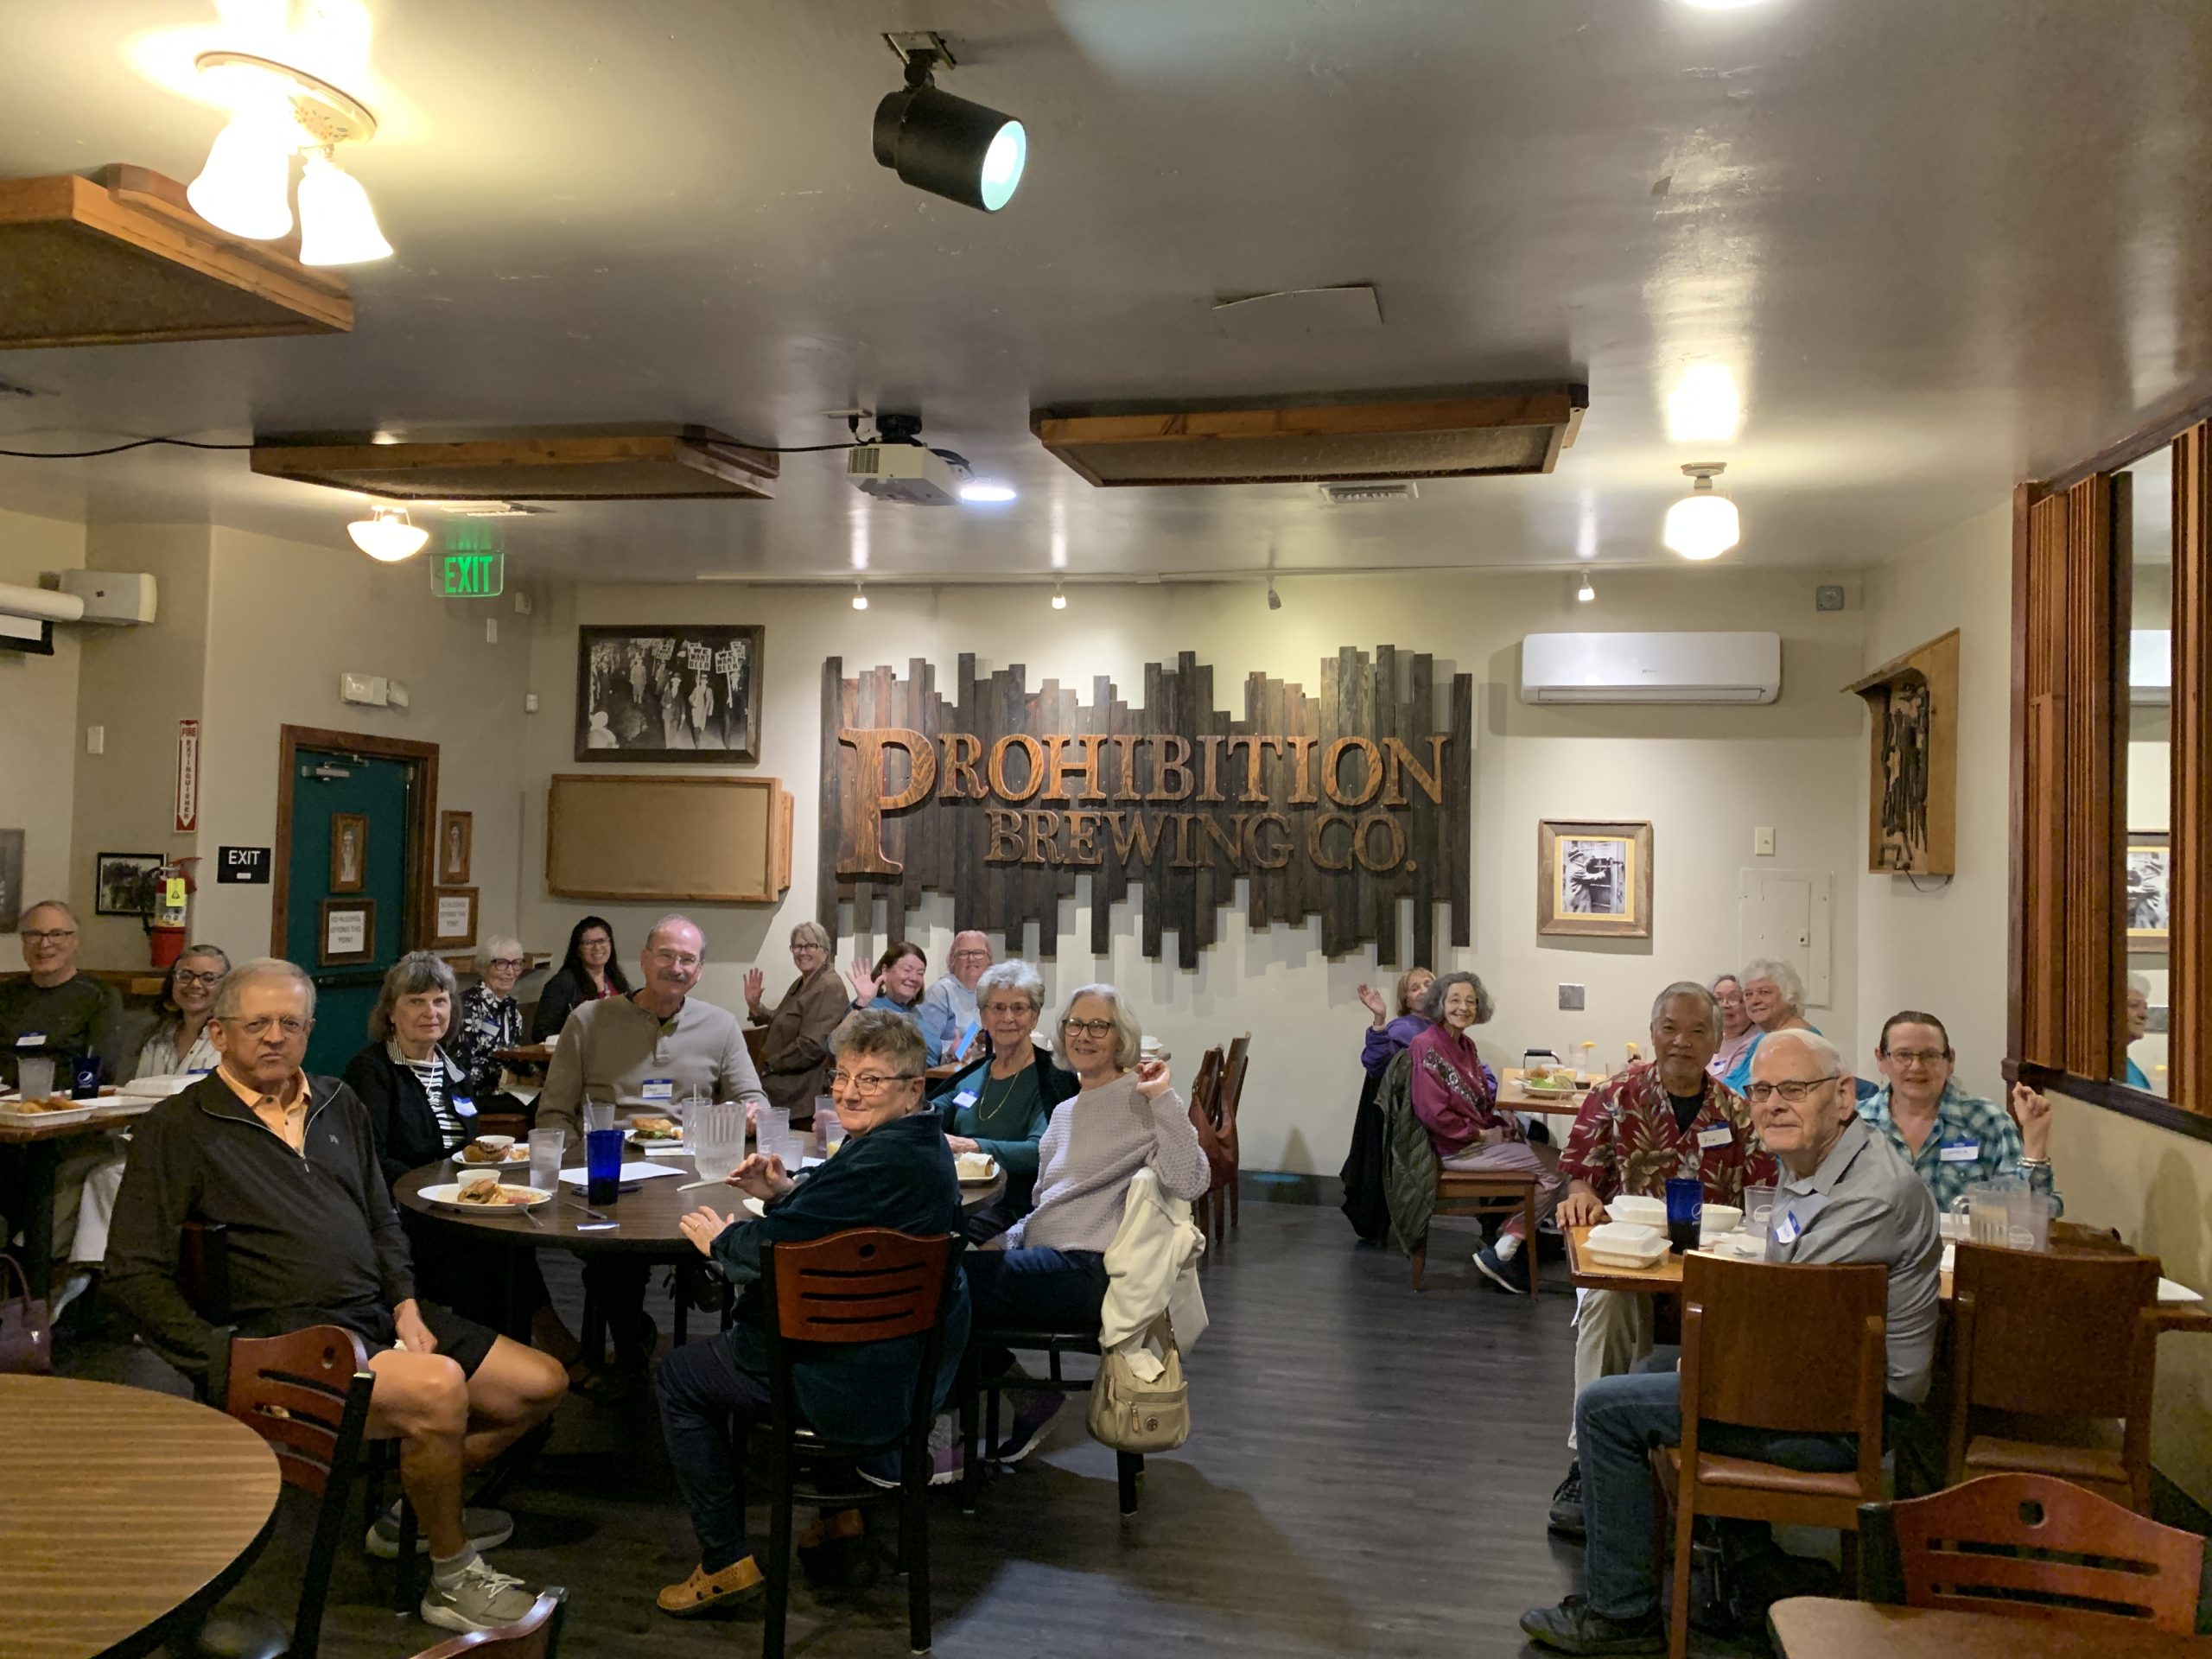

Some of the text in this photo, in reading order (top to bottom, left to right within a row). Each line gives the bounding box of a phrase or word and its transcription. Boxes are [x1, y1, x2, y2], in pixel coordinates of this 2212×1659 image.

[444, 556, 493, 593] EXIT
[717, 663, 738, 672] BEER
[837, 728, 1452, 875] PROHIBITION
[228, 849, 261, 865] EXIT
[984, 808, 1417, 874] BREWING CO.
